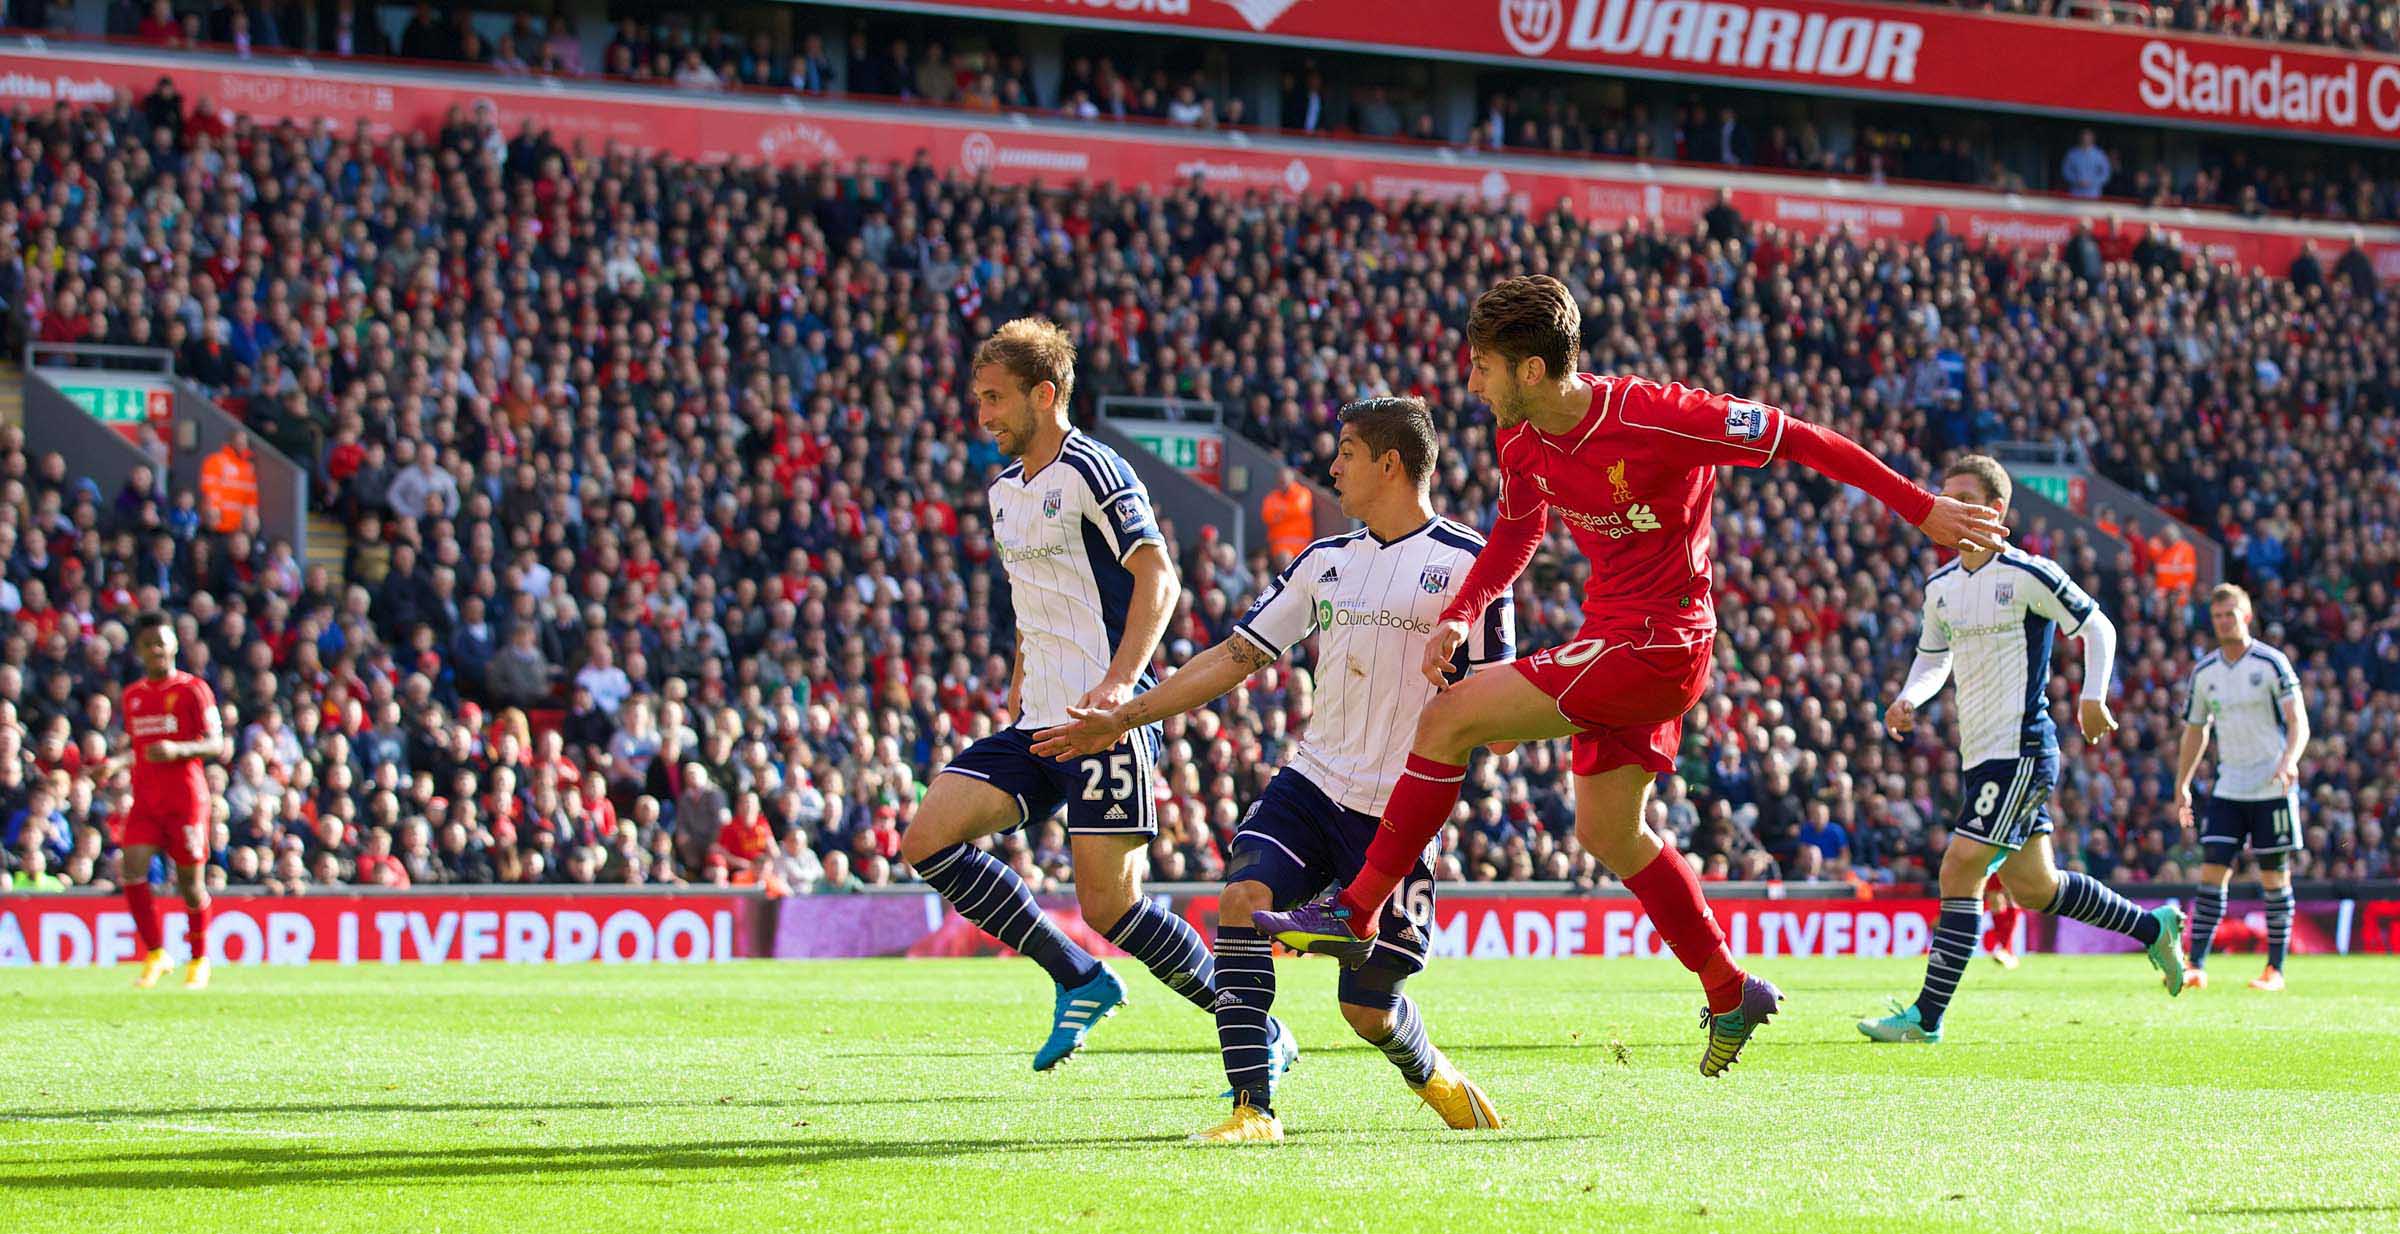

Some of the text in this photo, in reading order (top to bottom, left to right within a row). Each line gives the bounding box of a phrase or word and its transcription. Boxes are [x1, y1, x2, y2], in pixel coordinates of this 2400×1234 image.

[1567, 0, 1924, 83] WARRIOR
[2139, 40, 2357, 127] Standard
[1613, 491, 1633, 504] LFC
[1336, 609, 1431, 635] QuickBooks
[1081, 753, 1134, 801] 25
[1975, 781, 2000, 817] 8
[2272, 808, 2289, 835] 11
[1392, 877, 1431, 927] 16
[163, 910, 316, 967] FOR
[337, 909, 733, 966] LIVERPOOL
[1433, 910, 1588, 959] MADE
[1604, 911, 1674, 960] FO
